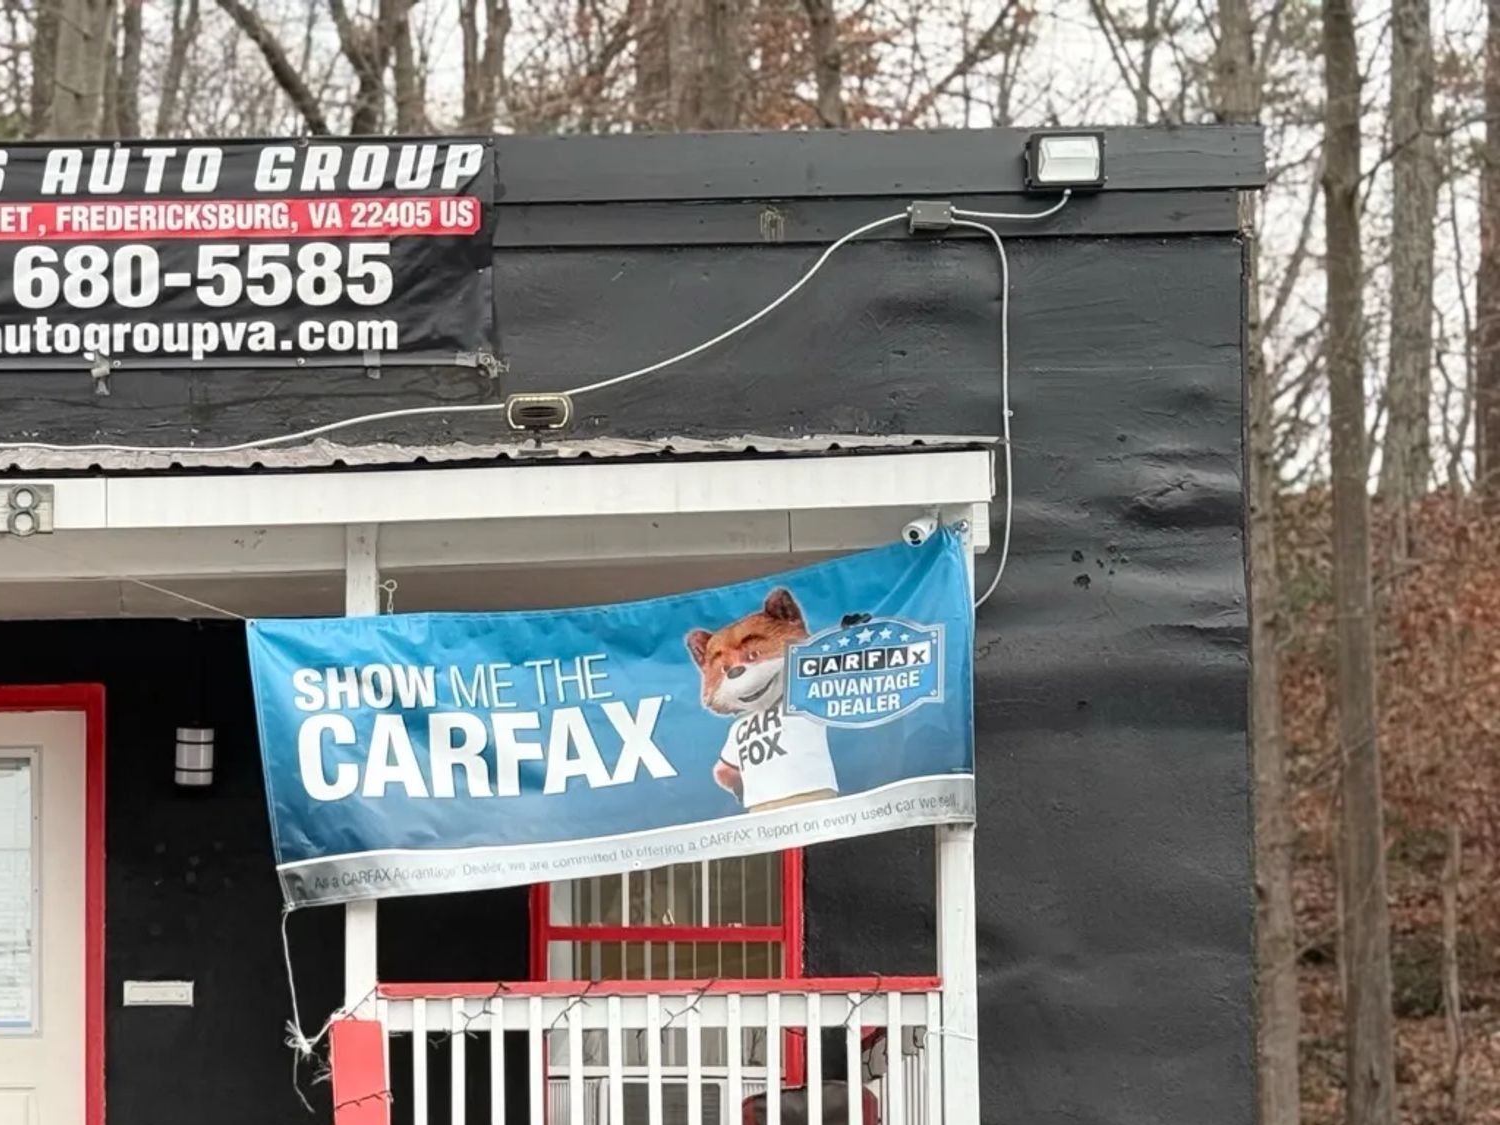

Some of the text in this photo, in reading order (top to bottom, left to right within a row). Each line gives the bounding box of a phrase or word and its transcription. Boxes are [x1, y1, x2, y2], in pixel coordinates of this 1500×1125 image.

[41, 146, 223, 195] AUTO
[254, 143, 484, 193] GROUP
[56, 202, 299, 234] FREDERICKSBURG,
[307, 201, 343, 229] VA
[350, 201, 432, 229] 22405
[439, 200, 475, 228] US
[12, 242, 394, 310] 680-5585
[292, 653, 613, 712] SHOW ME THE
[800, 645, 928, 677] CARFAX
[807, 669, 921, 699] ADVANTAGE
[735, 703, 783, 746] CAR
[826, 694, 901, 718] DEALER
[298, 694, 679, 802] CARFAX
[738, 731, 788, 772] FOX
[314, 876, 331, 890] As
[341, 867, 393, 888] CARFAX
[509, 862, 527, 873] we
[529, 860, 549, 871] are
[553, 848, 618, 869] committed
[621, 847, 633, 859] to
[636, 840, 685, 860] offering
[699, 829, 747, 850] CARFAX
[757, 821, 799, 842] Report
[803, 820, 820, 831] on
[823, 813, 858, 830] every
[860, 804, 893, 821] used
[895, 799, 917, 813] car
[919, 798, 938, 810] we
